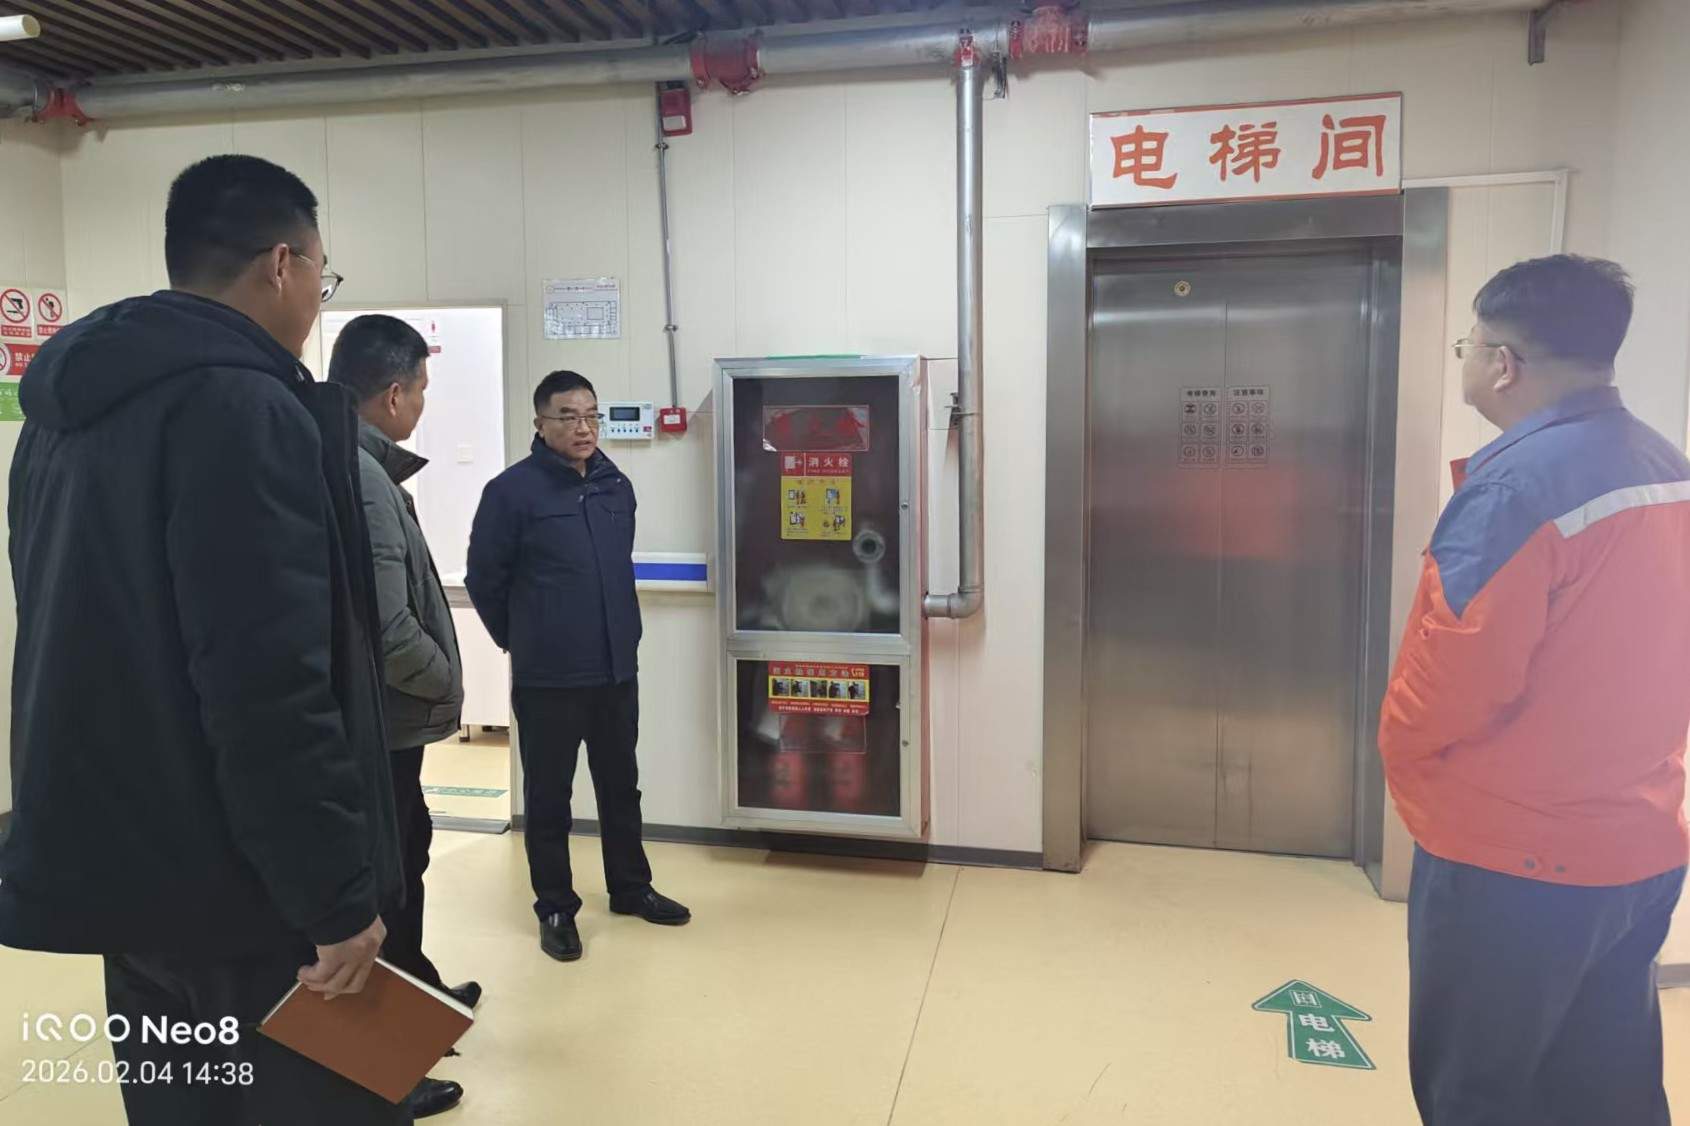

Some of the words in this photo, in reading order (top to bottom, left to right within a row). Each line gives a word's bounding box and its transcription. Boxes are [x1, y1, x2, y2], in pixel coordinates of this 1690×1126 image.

[1110, 113, 1387, 190] 电梯间
[808, 457, 849, 468] 消火栓
[1299, 1013, 1346, 1059] 电梯
